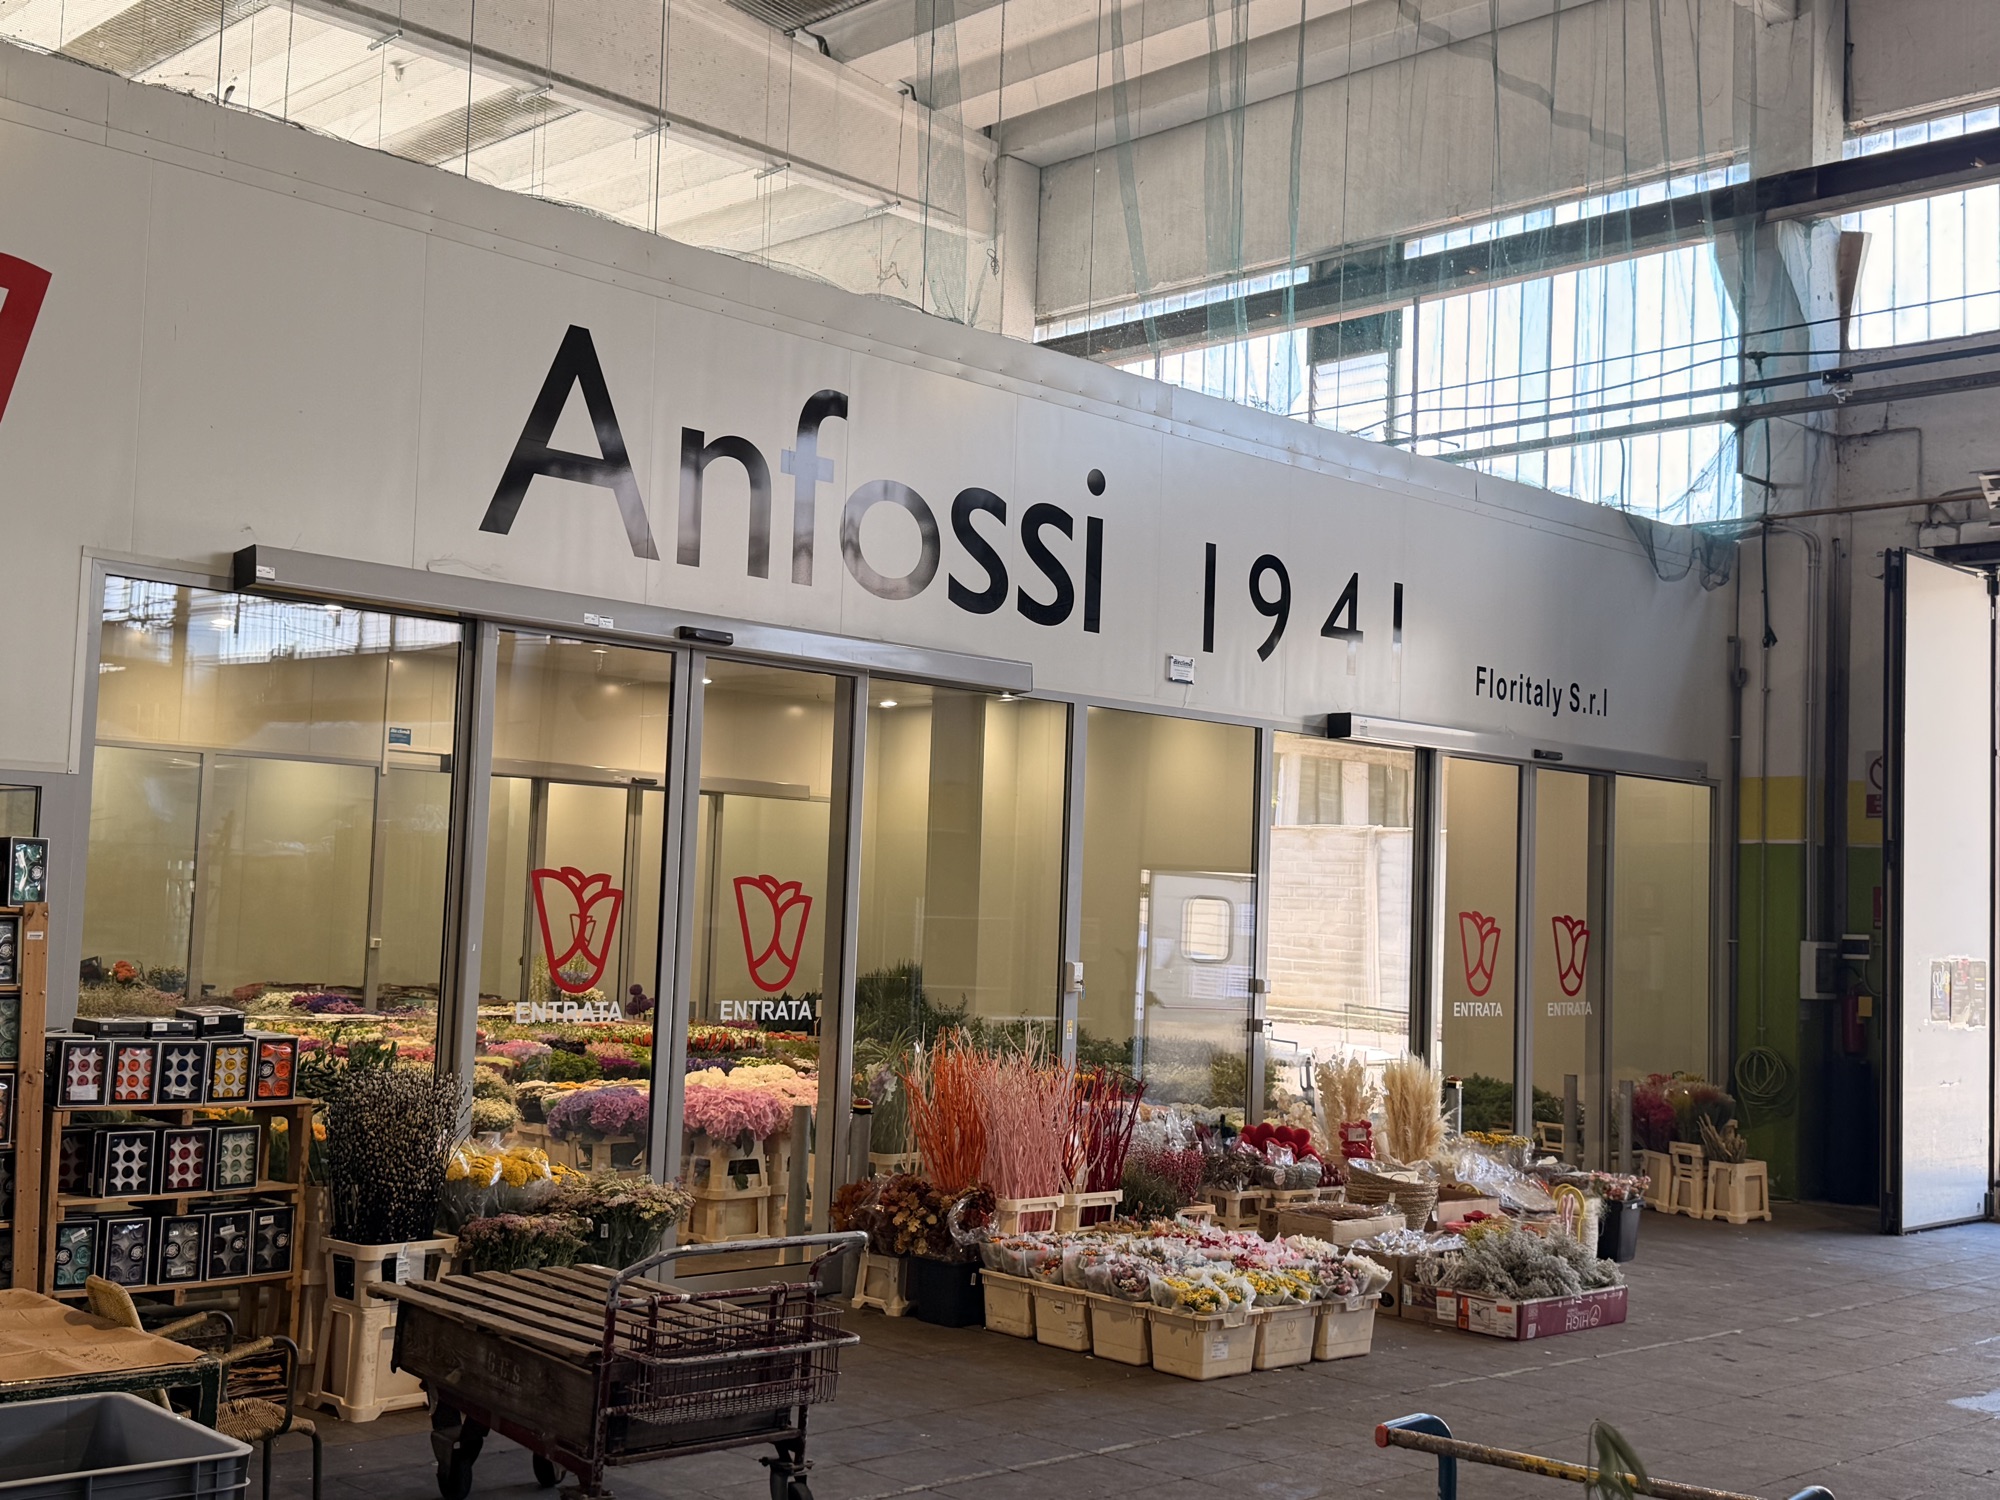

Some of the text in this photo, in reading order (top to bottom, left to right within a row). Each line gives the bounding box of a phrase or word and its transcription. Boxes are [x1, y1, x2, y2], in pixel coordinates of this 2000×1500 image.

[479, 325, 1404, 682] Anfossi 1941
[1475, 665, 1608, 717] Floritaly S.r.l
[515, 1000, 623, 1024] ENTRATA
[720, 999, 812, 1021] ENTRATA
[1453, 1001, 1503, 1017] ENTRATA
[1547, 1001, 1592, 1017] ENTRATA
[1565, 1314, 1590, 1331] HIGH
